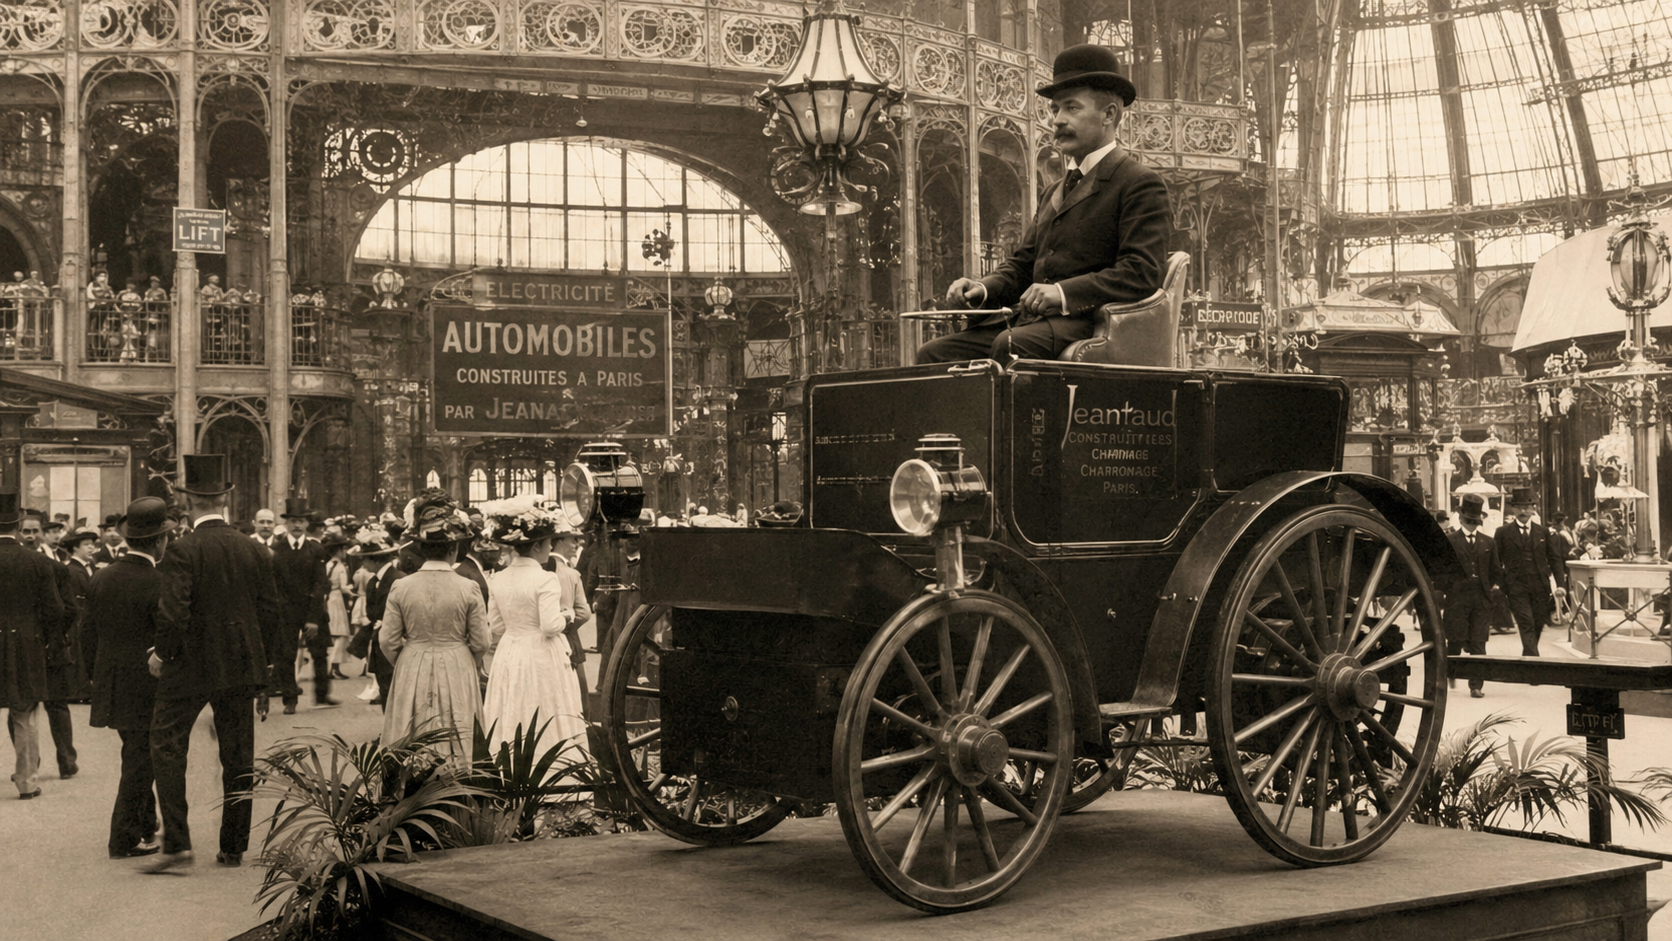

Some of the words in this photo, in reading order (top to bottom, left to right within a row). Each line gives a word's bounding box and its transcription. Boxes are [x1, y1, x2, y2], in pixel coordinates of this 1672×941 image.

[179, 225, 221, 242] LIFT
[442, 321, 656, 359] AUTOMOBILES
[456, 368, 567, 385] CONSTRUITES
[577, 372, 587, 386] A
[597, 371, 643, 387] PARIS
[444, 405, 475, 419] PAR
[1061, 384, 1178, 450] Jeantaud
